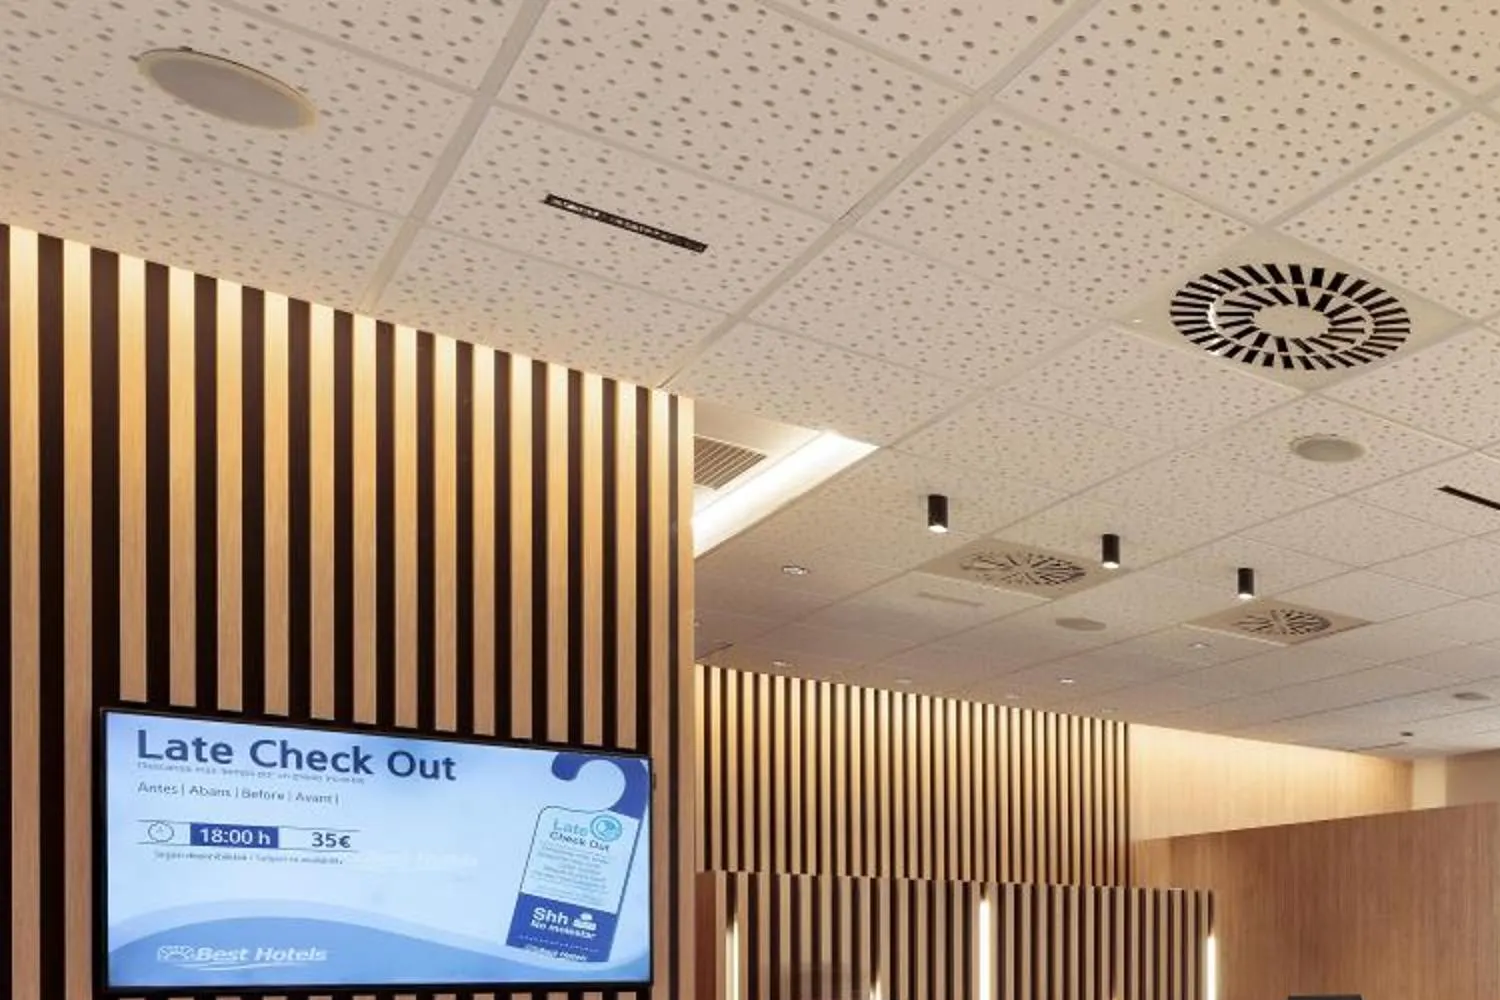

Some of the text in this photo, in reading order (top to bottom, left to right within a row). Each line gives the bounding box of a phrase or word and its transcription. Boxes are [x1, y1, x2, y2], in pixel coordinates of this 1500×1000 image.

[138, 730, 233, 764] Late
[249, 739, 374, 774] Check
[387, 750, 457, 781] Out
[137, 781, 178, 795] Antes
[241, 788, 285, 801] Before
[200, 828, 271, 845] 18:00 h
[311, 832, 351, 849] 35€
[533, 906, 569, 925] Shh
[196, 946, 328, 961] Best Hotels
